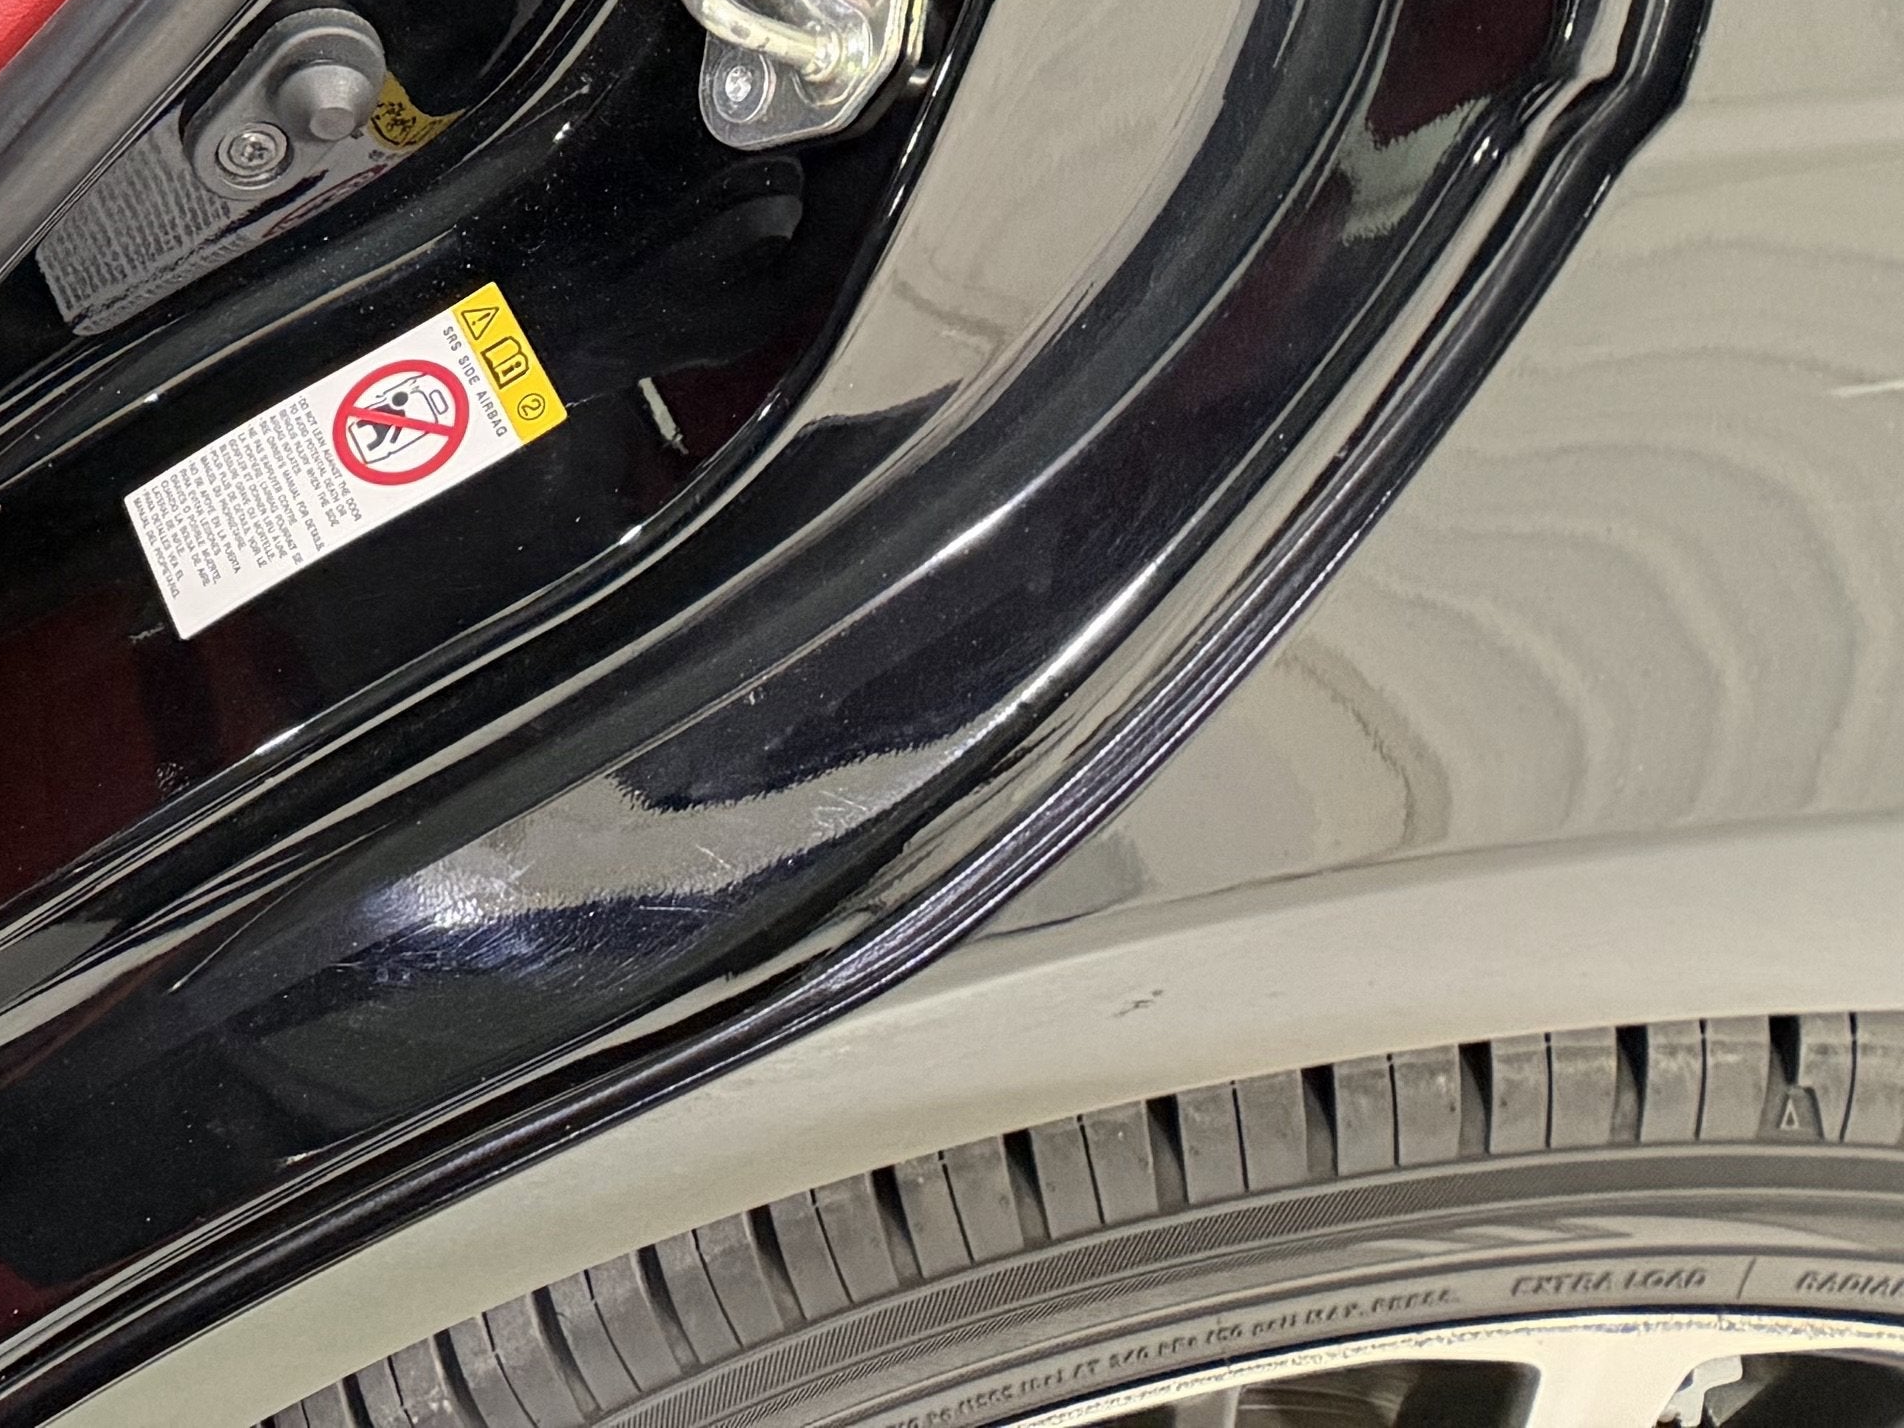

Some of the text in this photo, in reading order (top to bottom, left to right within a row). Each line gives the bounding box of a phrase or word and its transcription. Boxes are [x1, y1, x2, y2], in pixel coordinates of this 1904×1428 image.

[441, 324, 508, 438] SRS SIDE AIRBAG
[1511, 1268, 1708, 1297] EXTRA LOAD
